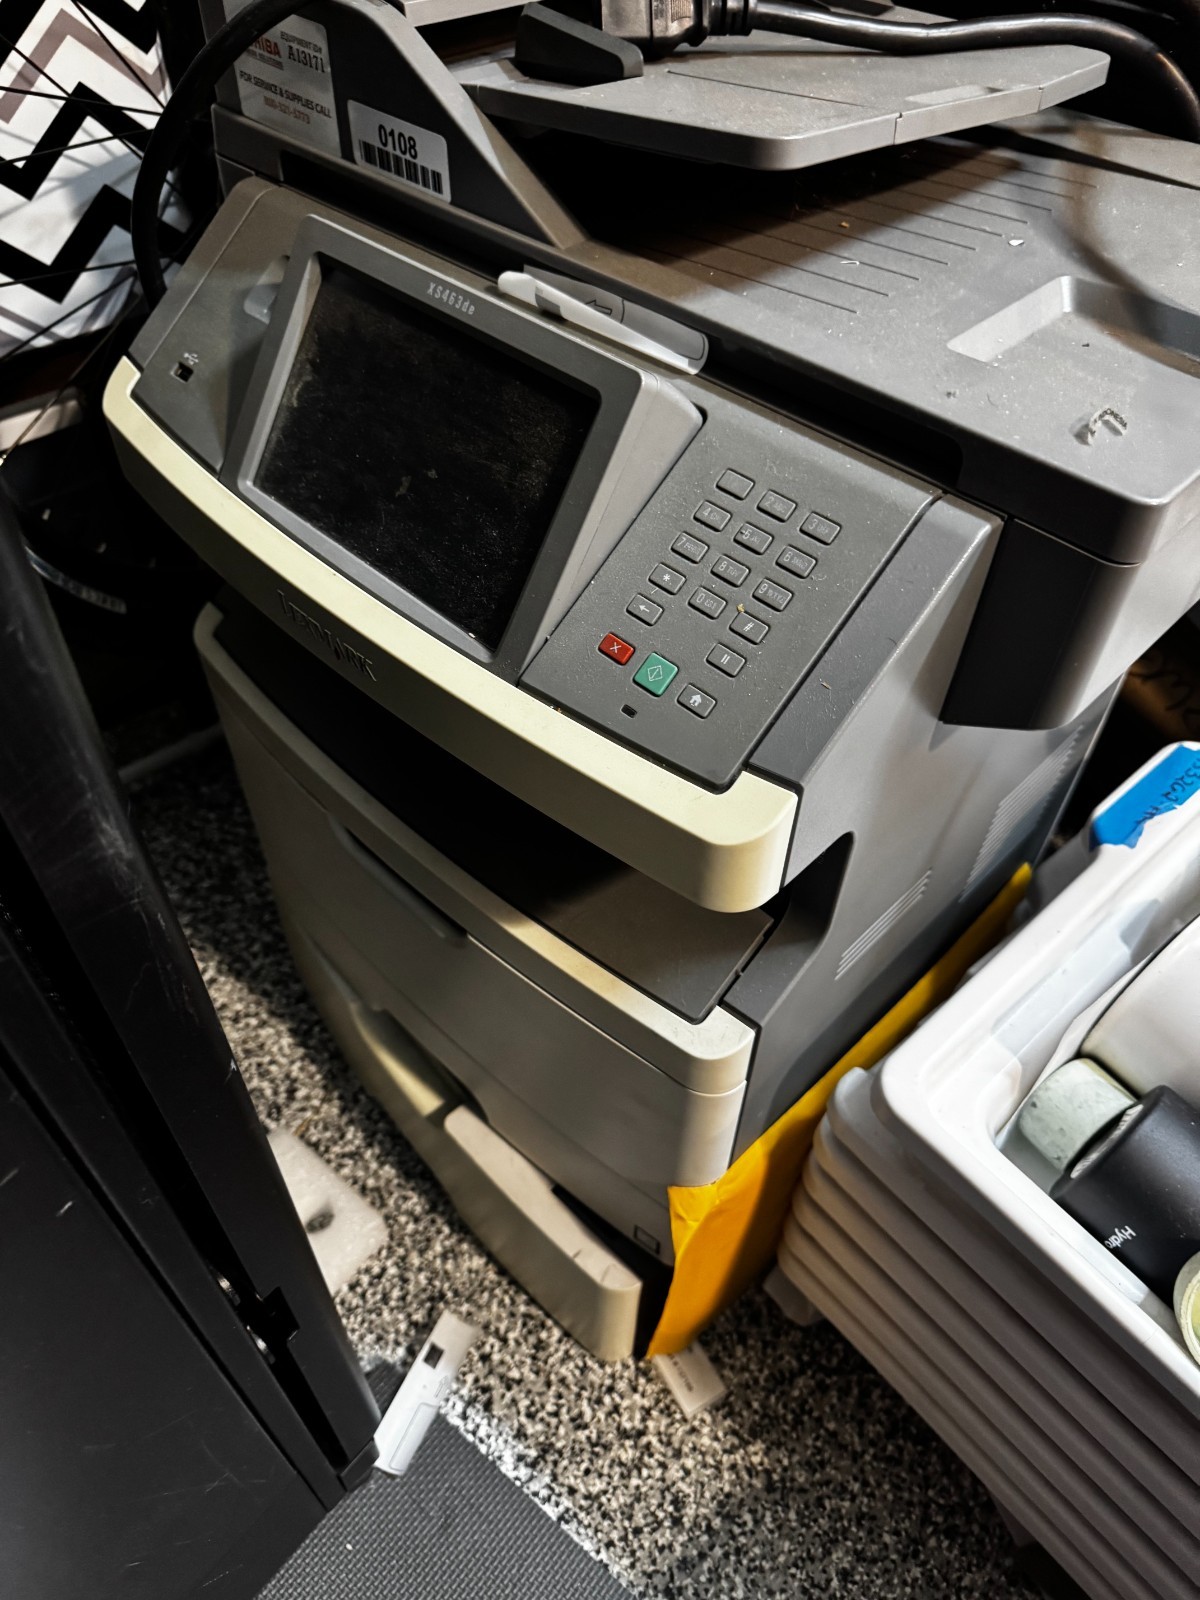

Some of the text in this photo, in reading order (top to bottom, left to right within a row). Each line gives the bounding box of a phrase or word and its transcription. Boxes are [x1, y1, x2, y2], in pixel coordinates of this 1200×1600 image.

[288, 44, 325, 73] A13171
[315, 102, 332, 119] CALL
[378, 124, 418, 160] 0108
[1103, 1224, 1138, 1250] Hydro
